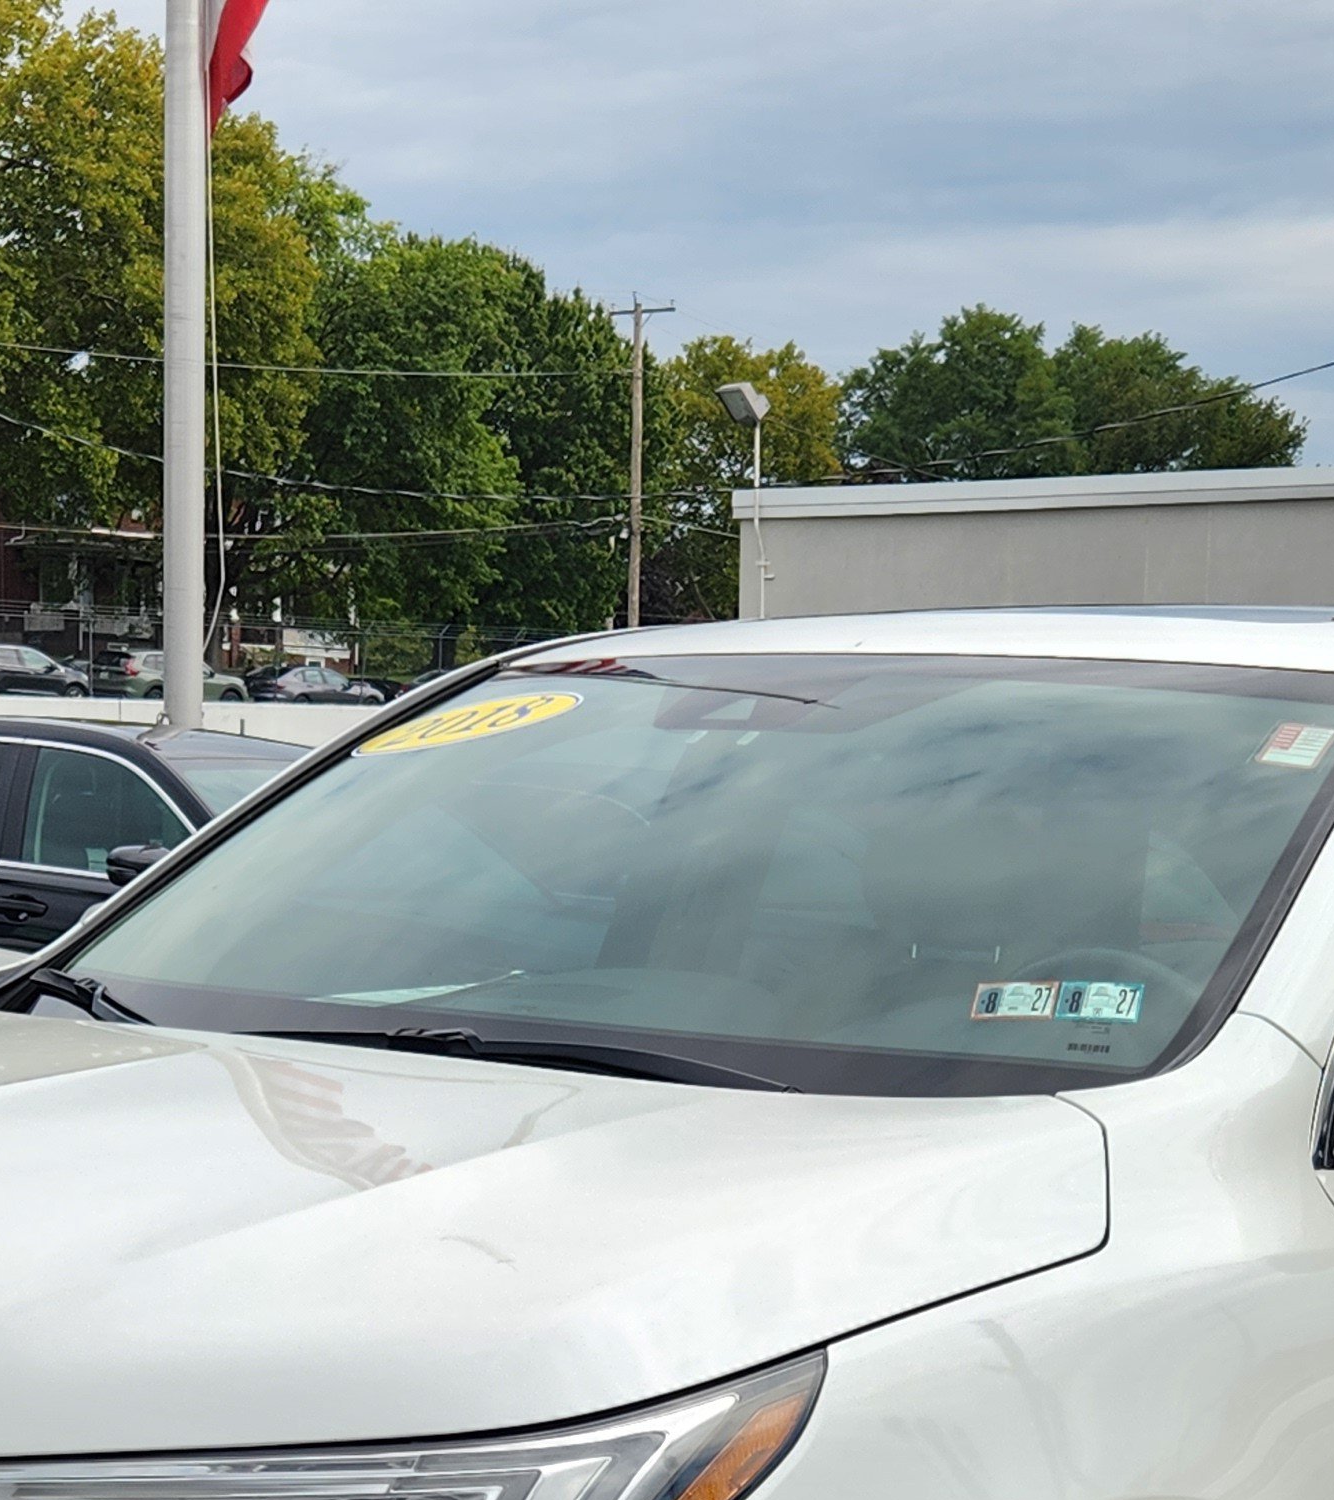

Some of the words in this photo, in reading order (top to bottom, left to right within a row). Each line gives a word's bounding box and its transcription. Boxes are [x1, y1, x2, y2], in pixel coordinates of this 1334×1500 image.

[375, 694, 556, 748] 2018
[1031, 987, 1053, 1015] 27
[1116, 988, 1139, 1017] 27
